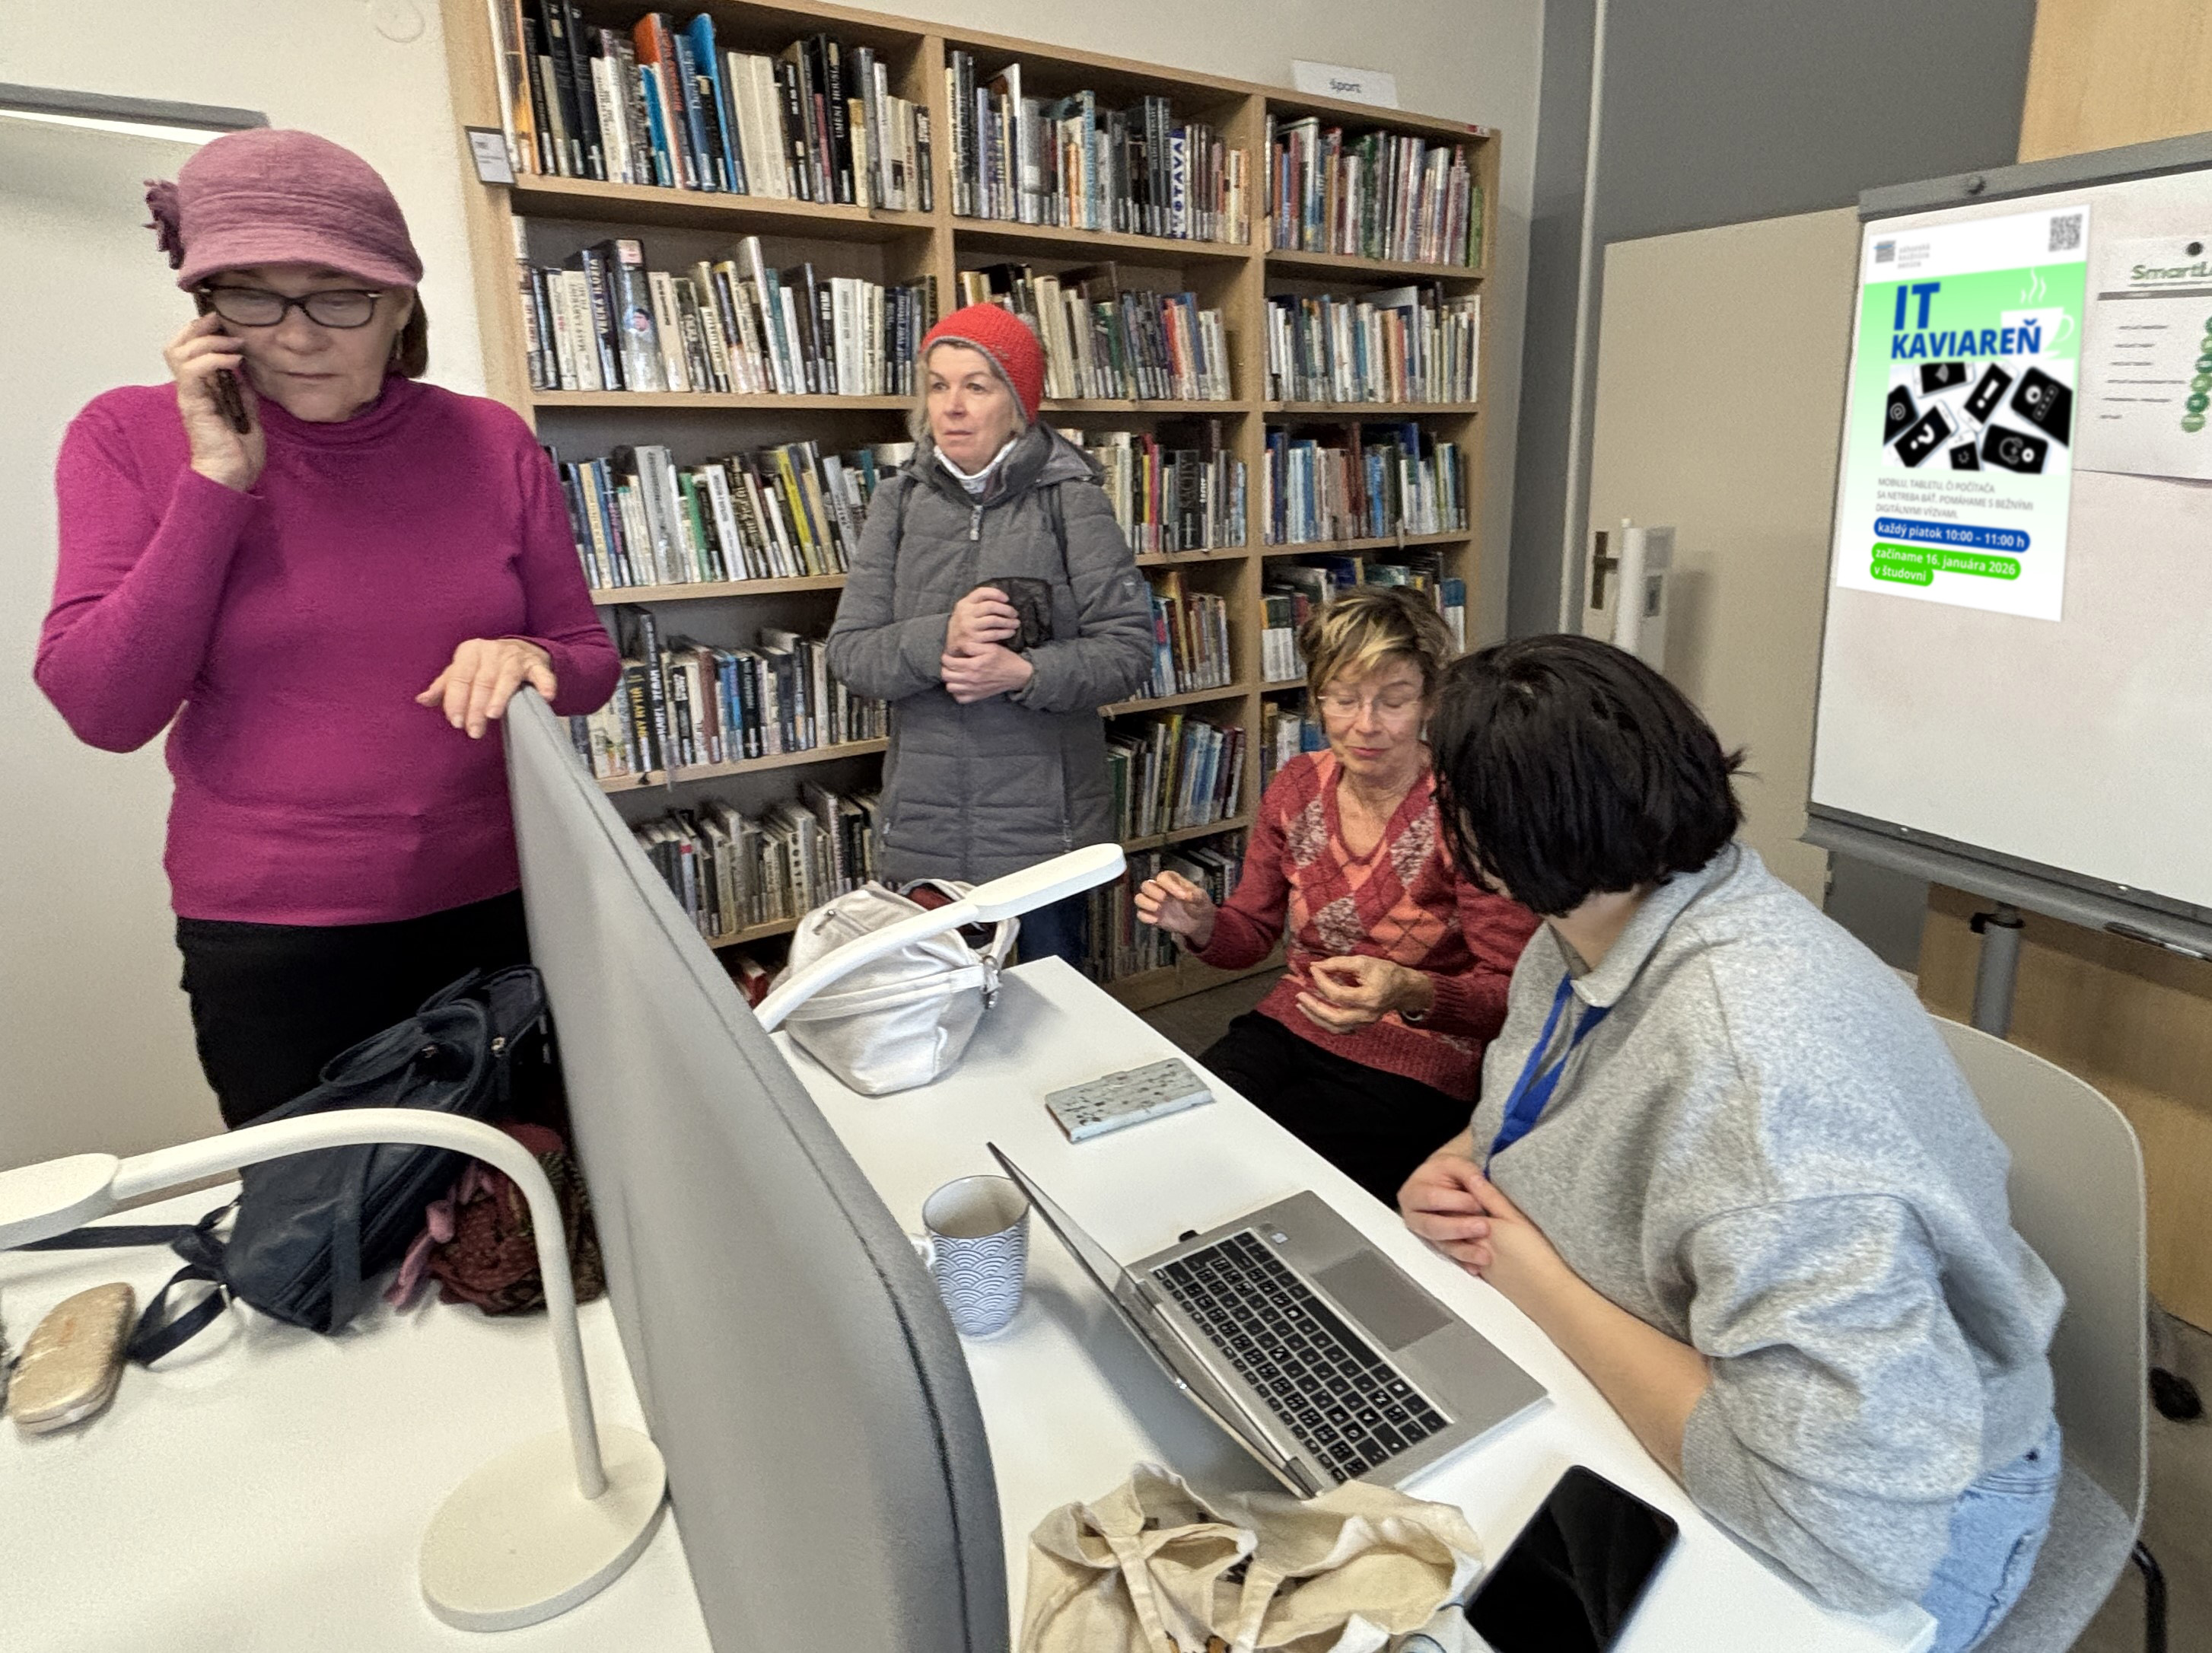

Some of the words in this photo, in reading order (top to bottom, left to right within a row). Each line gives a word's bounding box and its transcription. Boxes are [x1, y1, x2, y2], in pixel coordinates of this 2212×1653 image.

[1893, 282, 1941, 331] IT
[1891, 318, 2042, 360] KAVIAREŇ
[1878, 478, 1908, 488] MOBILU,
[1910, 479, 1943, 491] TABLETU,
[1946, 480, 1954, 491] ČI
[1956, 482, 1995, 493] POČÍTAČA
[1876, 491, 1886, 499] SA
[1887, 492, 1920, 502] NETREBA
[1921, 492, 1937, 503] BÁŤ.
[1939, 495, 1987, 508] POMÁHAME
[1988, 498, 1994, 508] S
[1995, 498, 2034, 511] BEŽNÝMI
[1876, 503, 1922, 516] DIGITÁLNYMI
[1924, 505, 1959, 519] VÝZVAMI.
[1878, 522, 1906, 537] každý
[1908, 524, 1943, 539] piatok
[1946, 529, 1974, 543] 10:00
[1984, 533, 2015, 546] 11:00
[2016, 535, 2025, 548] h
[1874, 566, 1881, 575] v
[1882, 564, 1927, 581] študovni
[1876, 547, 1923, 563] začíname
[1926, 554, 1940, 565] 16.
[1942, 555, 1986, 572] januára
[1988, 561, 2016, 575] 2026
